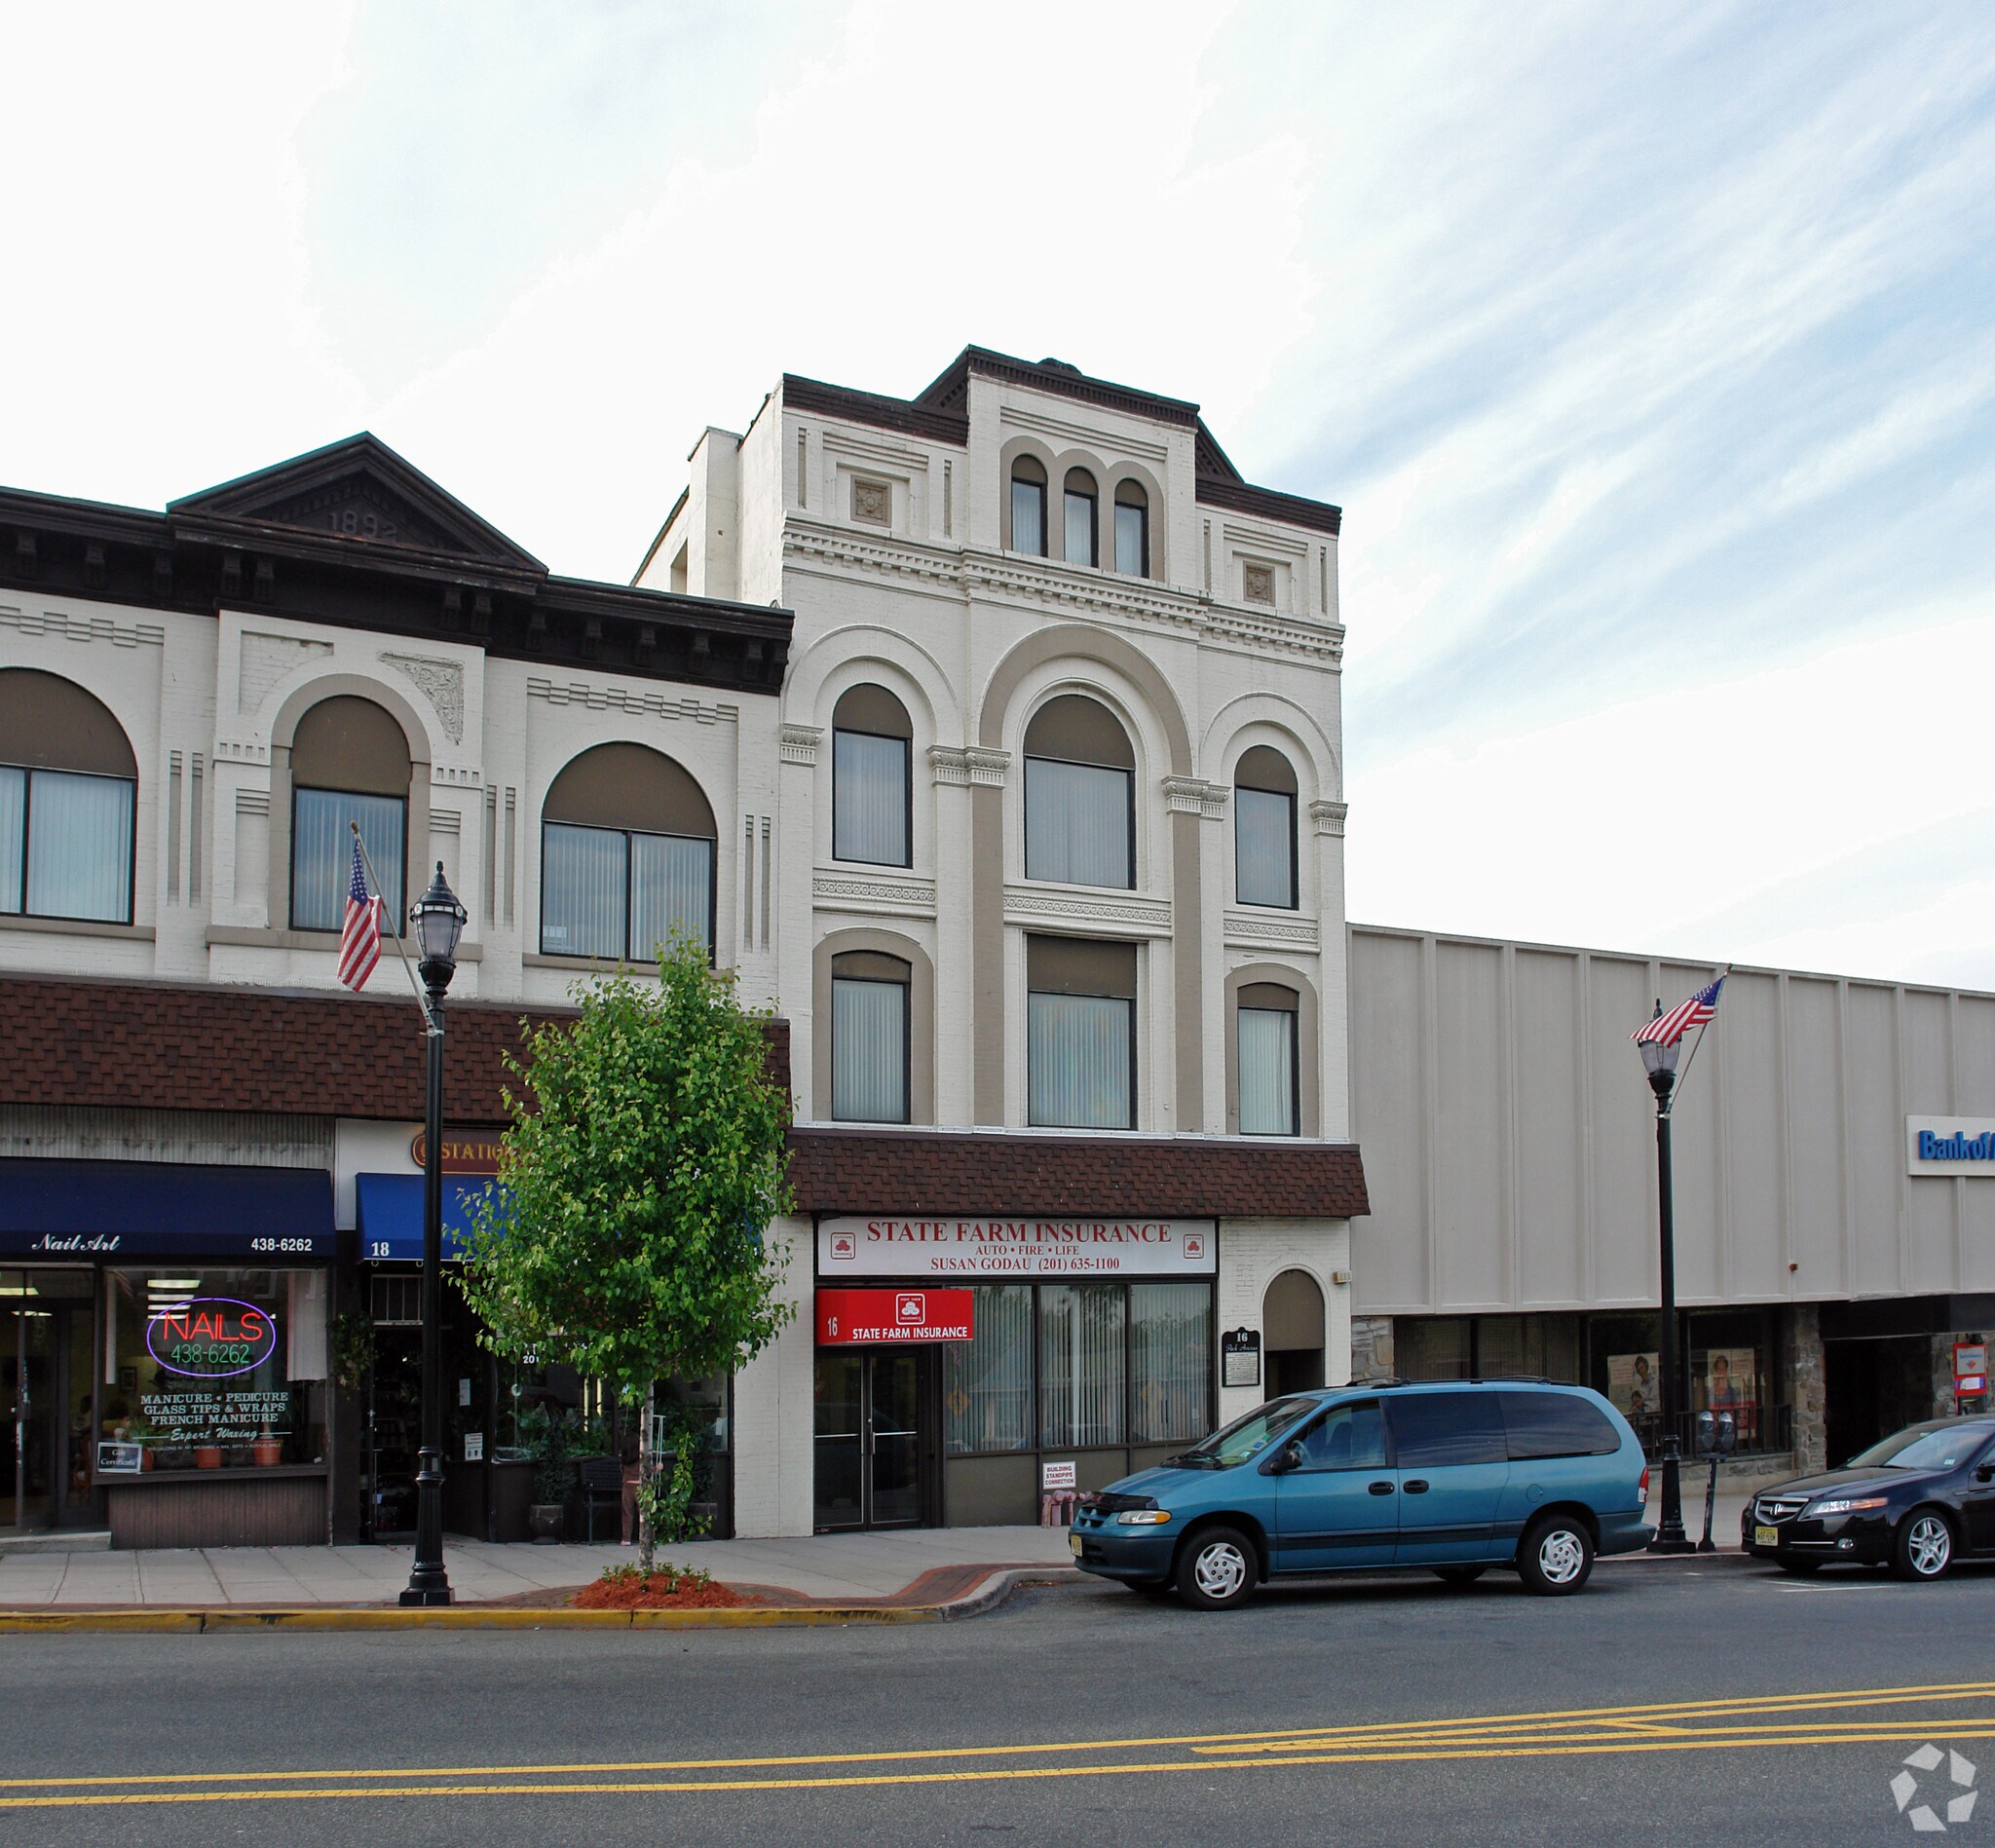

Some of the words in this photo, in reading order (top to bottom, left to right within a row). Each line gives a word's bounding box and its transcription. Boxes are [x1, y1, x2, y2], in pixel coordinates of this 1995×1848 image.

[441, 1142, 510, 1161] STATIO
[1918, 1130, 1970, 1160] Bank
[1970, 1131, 1990, 1160] of
[867, 1221, 952, 1242] STATE
[956, 1222, 1029, 1243] FARM
[1035, 1224, 1172, 1243] INSURANCE
[31, 1233, 81, 1251] Nail
[80, 1233, 121, 1251] Art
[250, 1237, 313, 1252] 438-6262
[371, 1241, 390, 1257] 18
[975, 1245, 1007, 1256] AUTO
[1018, 1245, 1044, 1256] FIRE
[1055, 1245, 1079, 1256] LIFE
[930, 1257, 977, 1270] SUSAN
[981, 1257, 1032, 1270] GODAU
[1038, 1258, 1068, 1272] (201)
[1071, 1258, 1120, 1270] 635-1100
[163, 1311, 263, 1341] NAILS
[827, 1316, 838, 1337] 16
[852, 1328, 881, 1339] STATE
[882, 1327, 911, 1339] FARM
[913, 1326, 968, 1339] INSURANCE
[1236, 1332, 1248, 1342] 16
[170, 1343, 249, 1364] 438-6262
[140, 1393, 212, 1405] MANICURE
[225, 1392, 288, 1403] PEDICURE
[143, 1405, 186, 1414] GLASS
[191, 1404, 220, 1414] TIPS
[225, 1404, 234, 1414] &
[239, 1403, 285, 1413] WRAPS
[151, 1414, 204, 1425] FRENCH
[208, 1414, 279, 1424] MANICURE
[170, 1427, 211, 1442] Expert
[215, 1426, 258, 1441] Waxing
